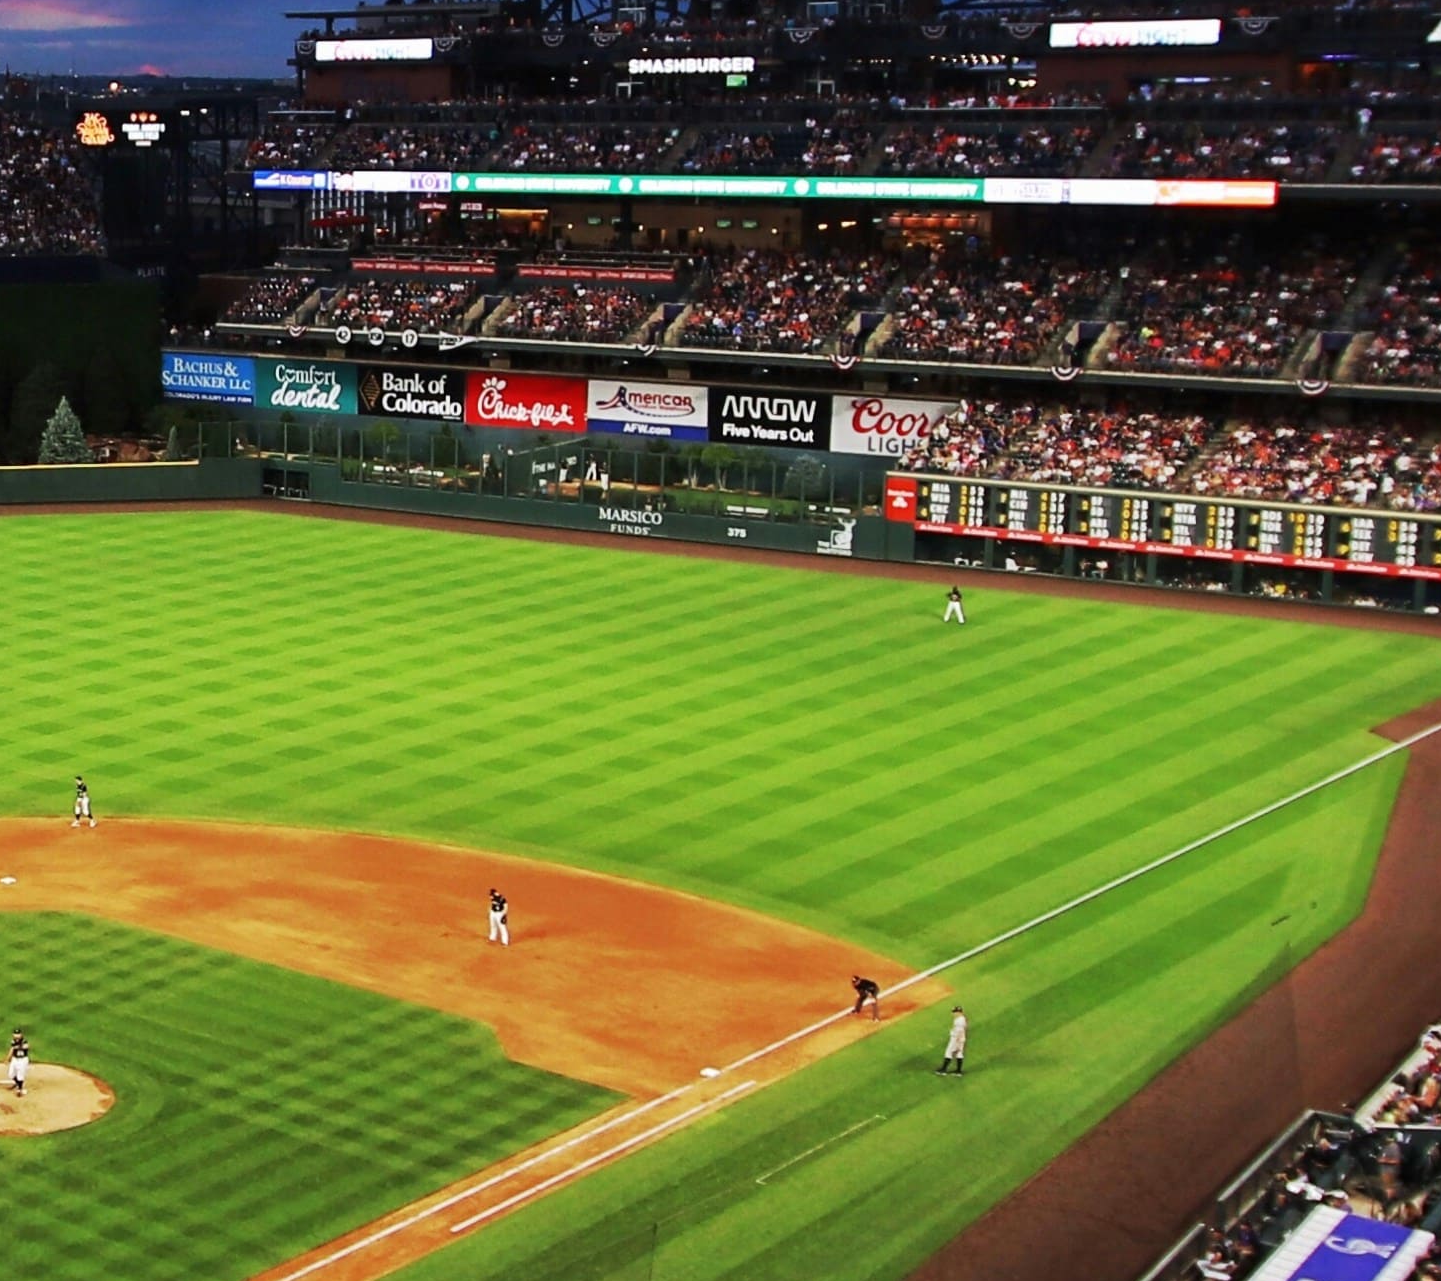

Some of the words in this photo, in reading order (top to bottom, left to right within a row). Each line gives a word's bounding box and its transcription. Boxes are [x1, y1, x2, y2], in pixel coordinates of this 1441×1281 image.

[629, 58, 754, 74] SMASHBURGER
[174, 357, 223, 375] BACHUS
[224, 361, 239, 377] &
[275, 364, 336, 386] Comfort
[162, 370, 226, 389] SCHANKER
[229, 379, 251, 391] LLC
[382, 373, 425, 393] Bank
[428, 375, 447, 394] of
[271, 382, 342, 410] dental
[382, 393, 462, 416] Colorado
[478, 379, 574, 426] Chick-fil-A
[852, 399, 931, 438] Coor
[623, 423, 672, 436] AFW.com
[722, 424, 751, 437] Five
[752, 426, 787, 440] Years
[790, 428, 814, 443] Out
[868, 436, 916, 454] LIGH
[599, 508, 662, 525] MARSICO
[610, 524, 650, 536] FUNDS
[727, 528, 746, 538] 375
